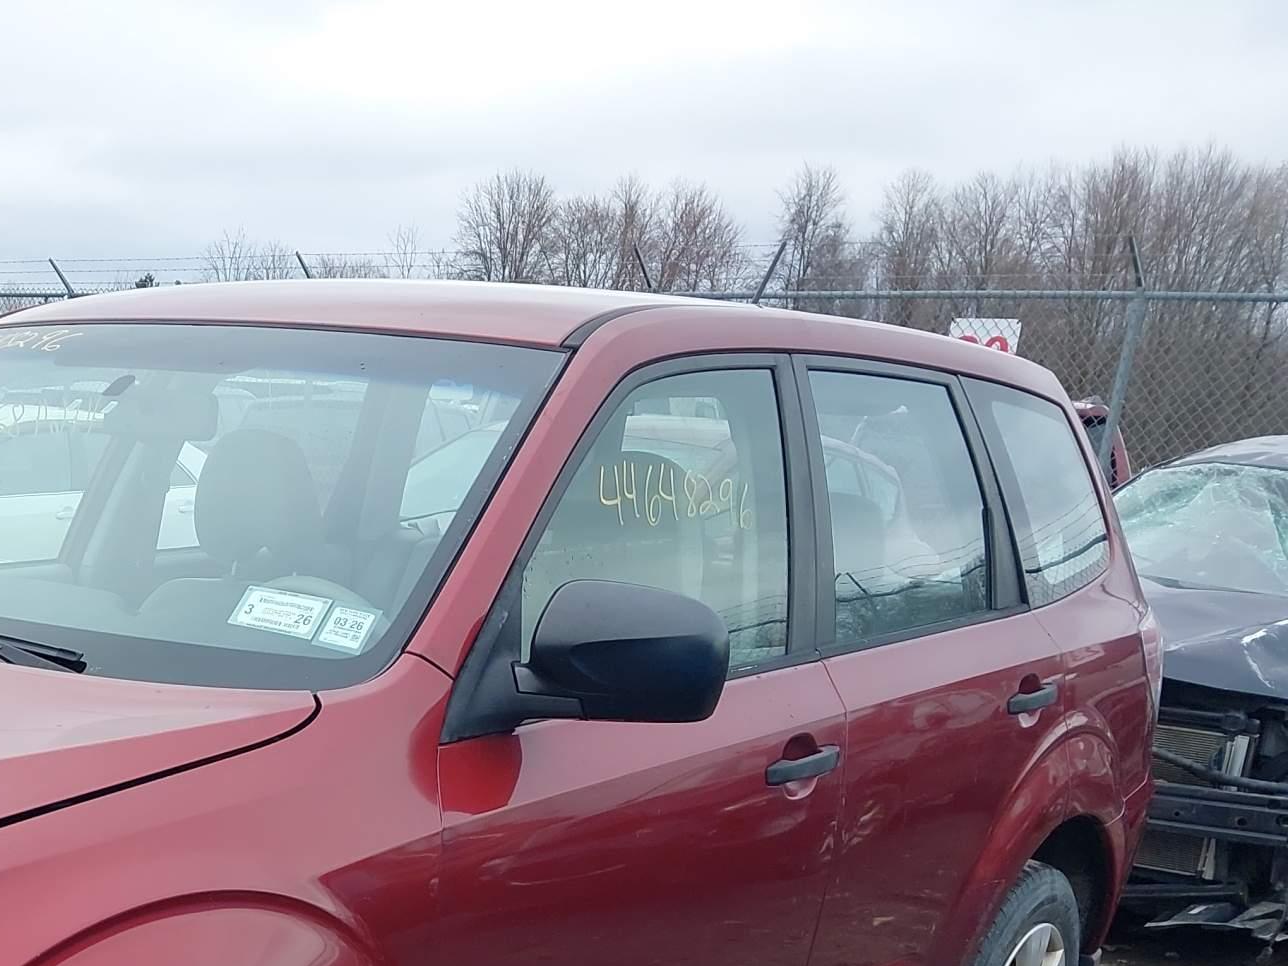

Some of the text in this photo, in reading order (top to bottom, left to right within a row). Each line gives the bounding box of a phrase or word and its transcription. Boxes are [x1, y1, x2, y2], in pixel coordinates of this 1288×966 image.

[599, 459, 753, 530] 44648296
[244, 603, 255, 615] 3
[294, 613, 313, 626] 26
